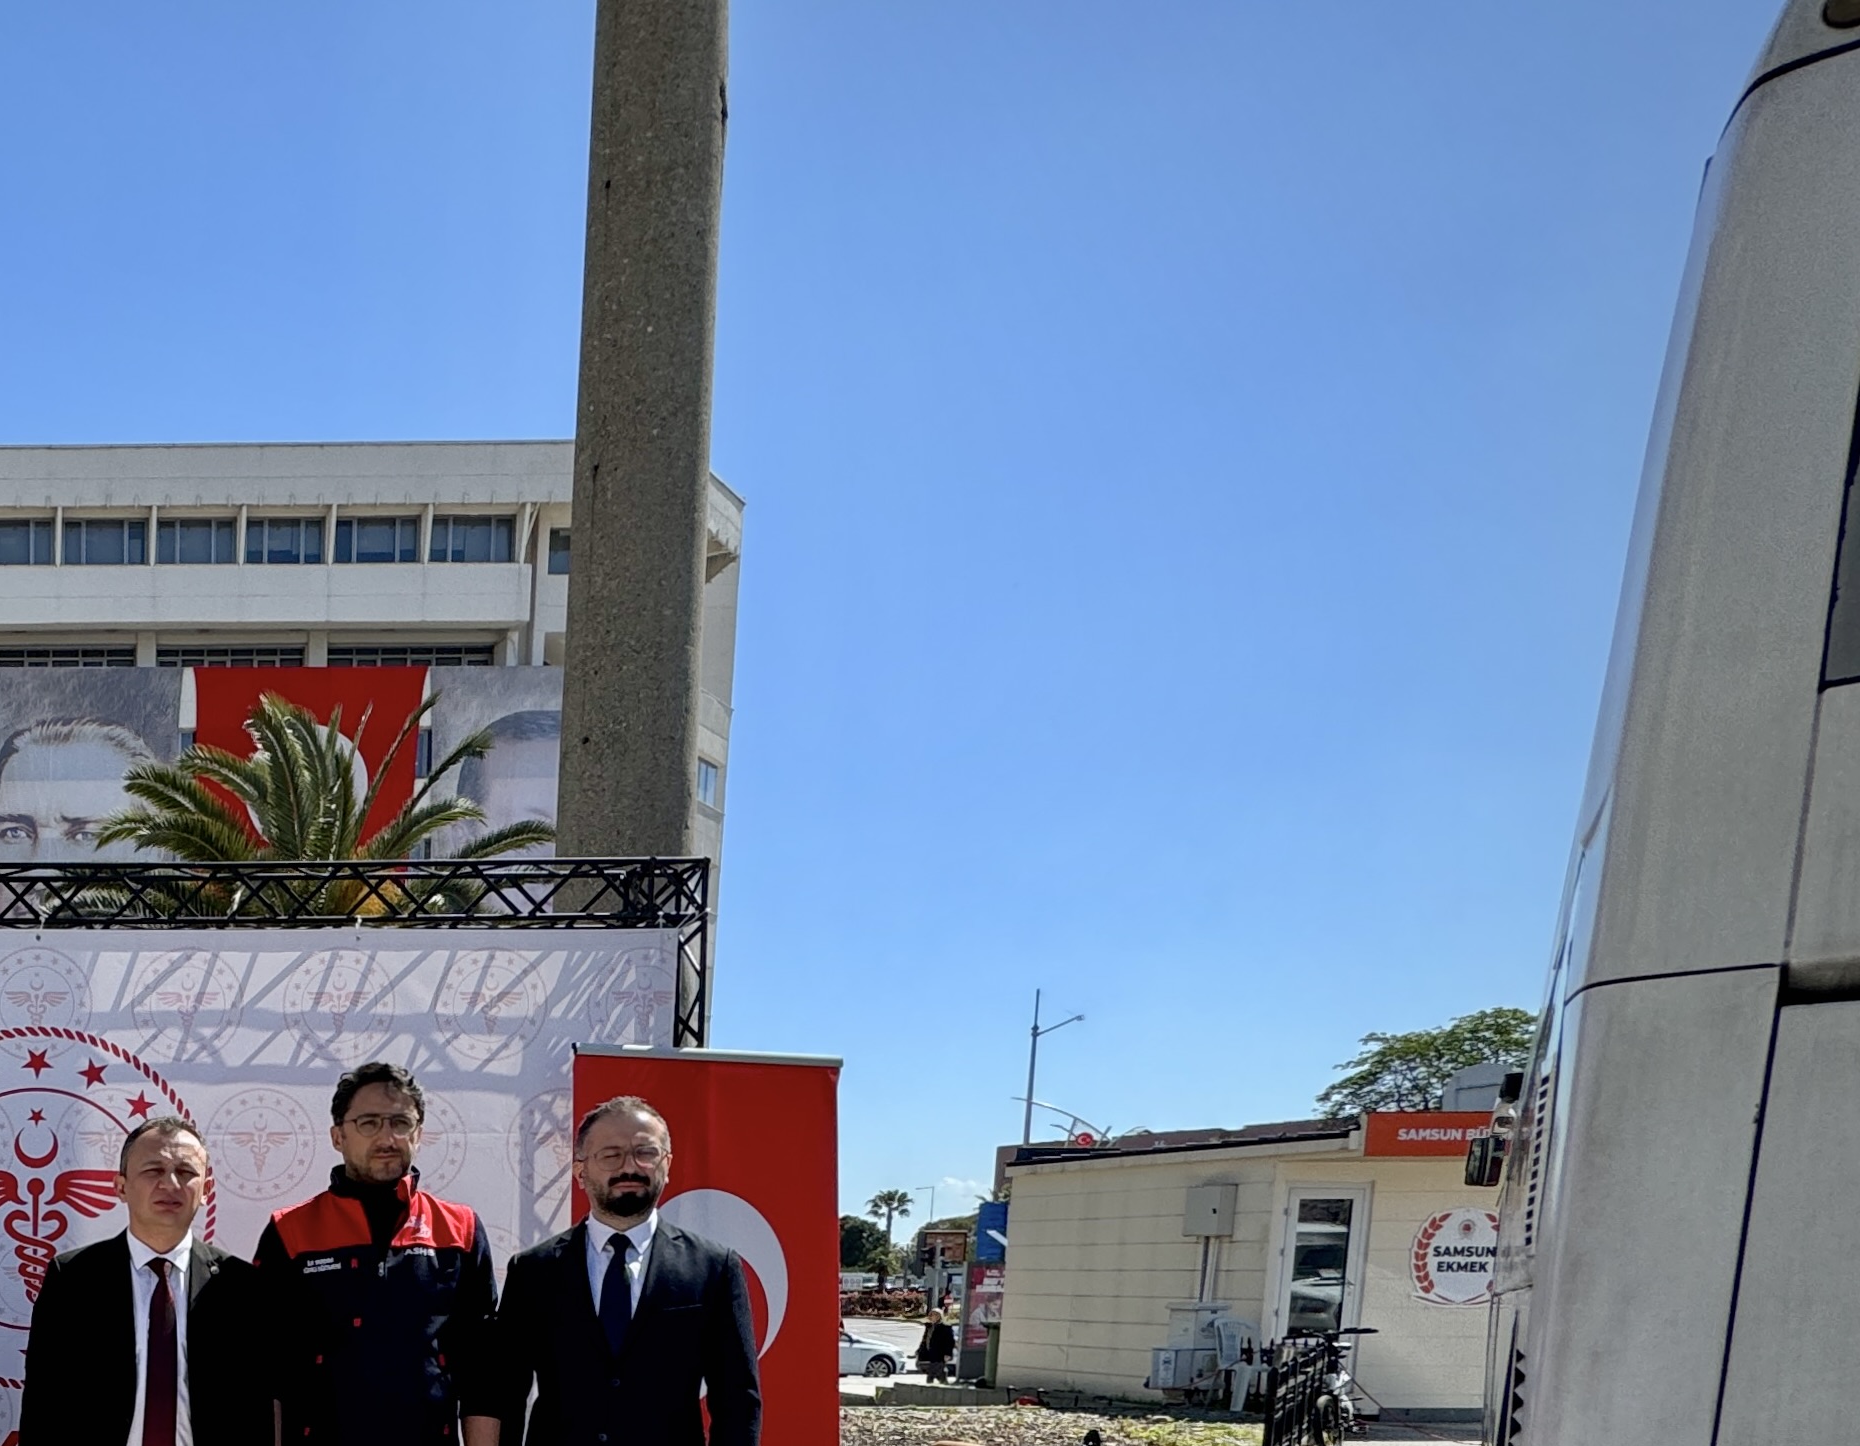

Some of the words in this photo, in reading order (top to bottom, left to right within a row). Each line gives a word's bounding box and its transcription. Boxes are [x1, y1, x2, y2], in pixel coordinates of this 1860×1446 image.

[1397, 1128, 1461, 1141] SAMSUN
[1432, 1245, 1497, 1258] SAMSUN
[1436, 1261, 1490, 1273] EKMEK
